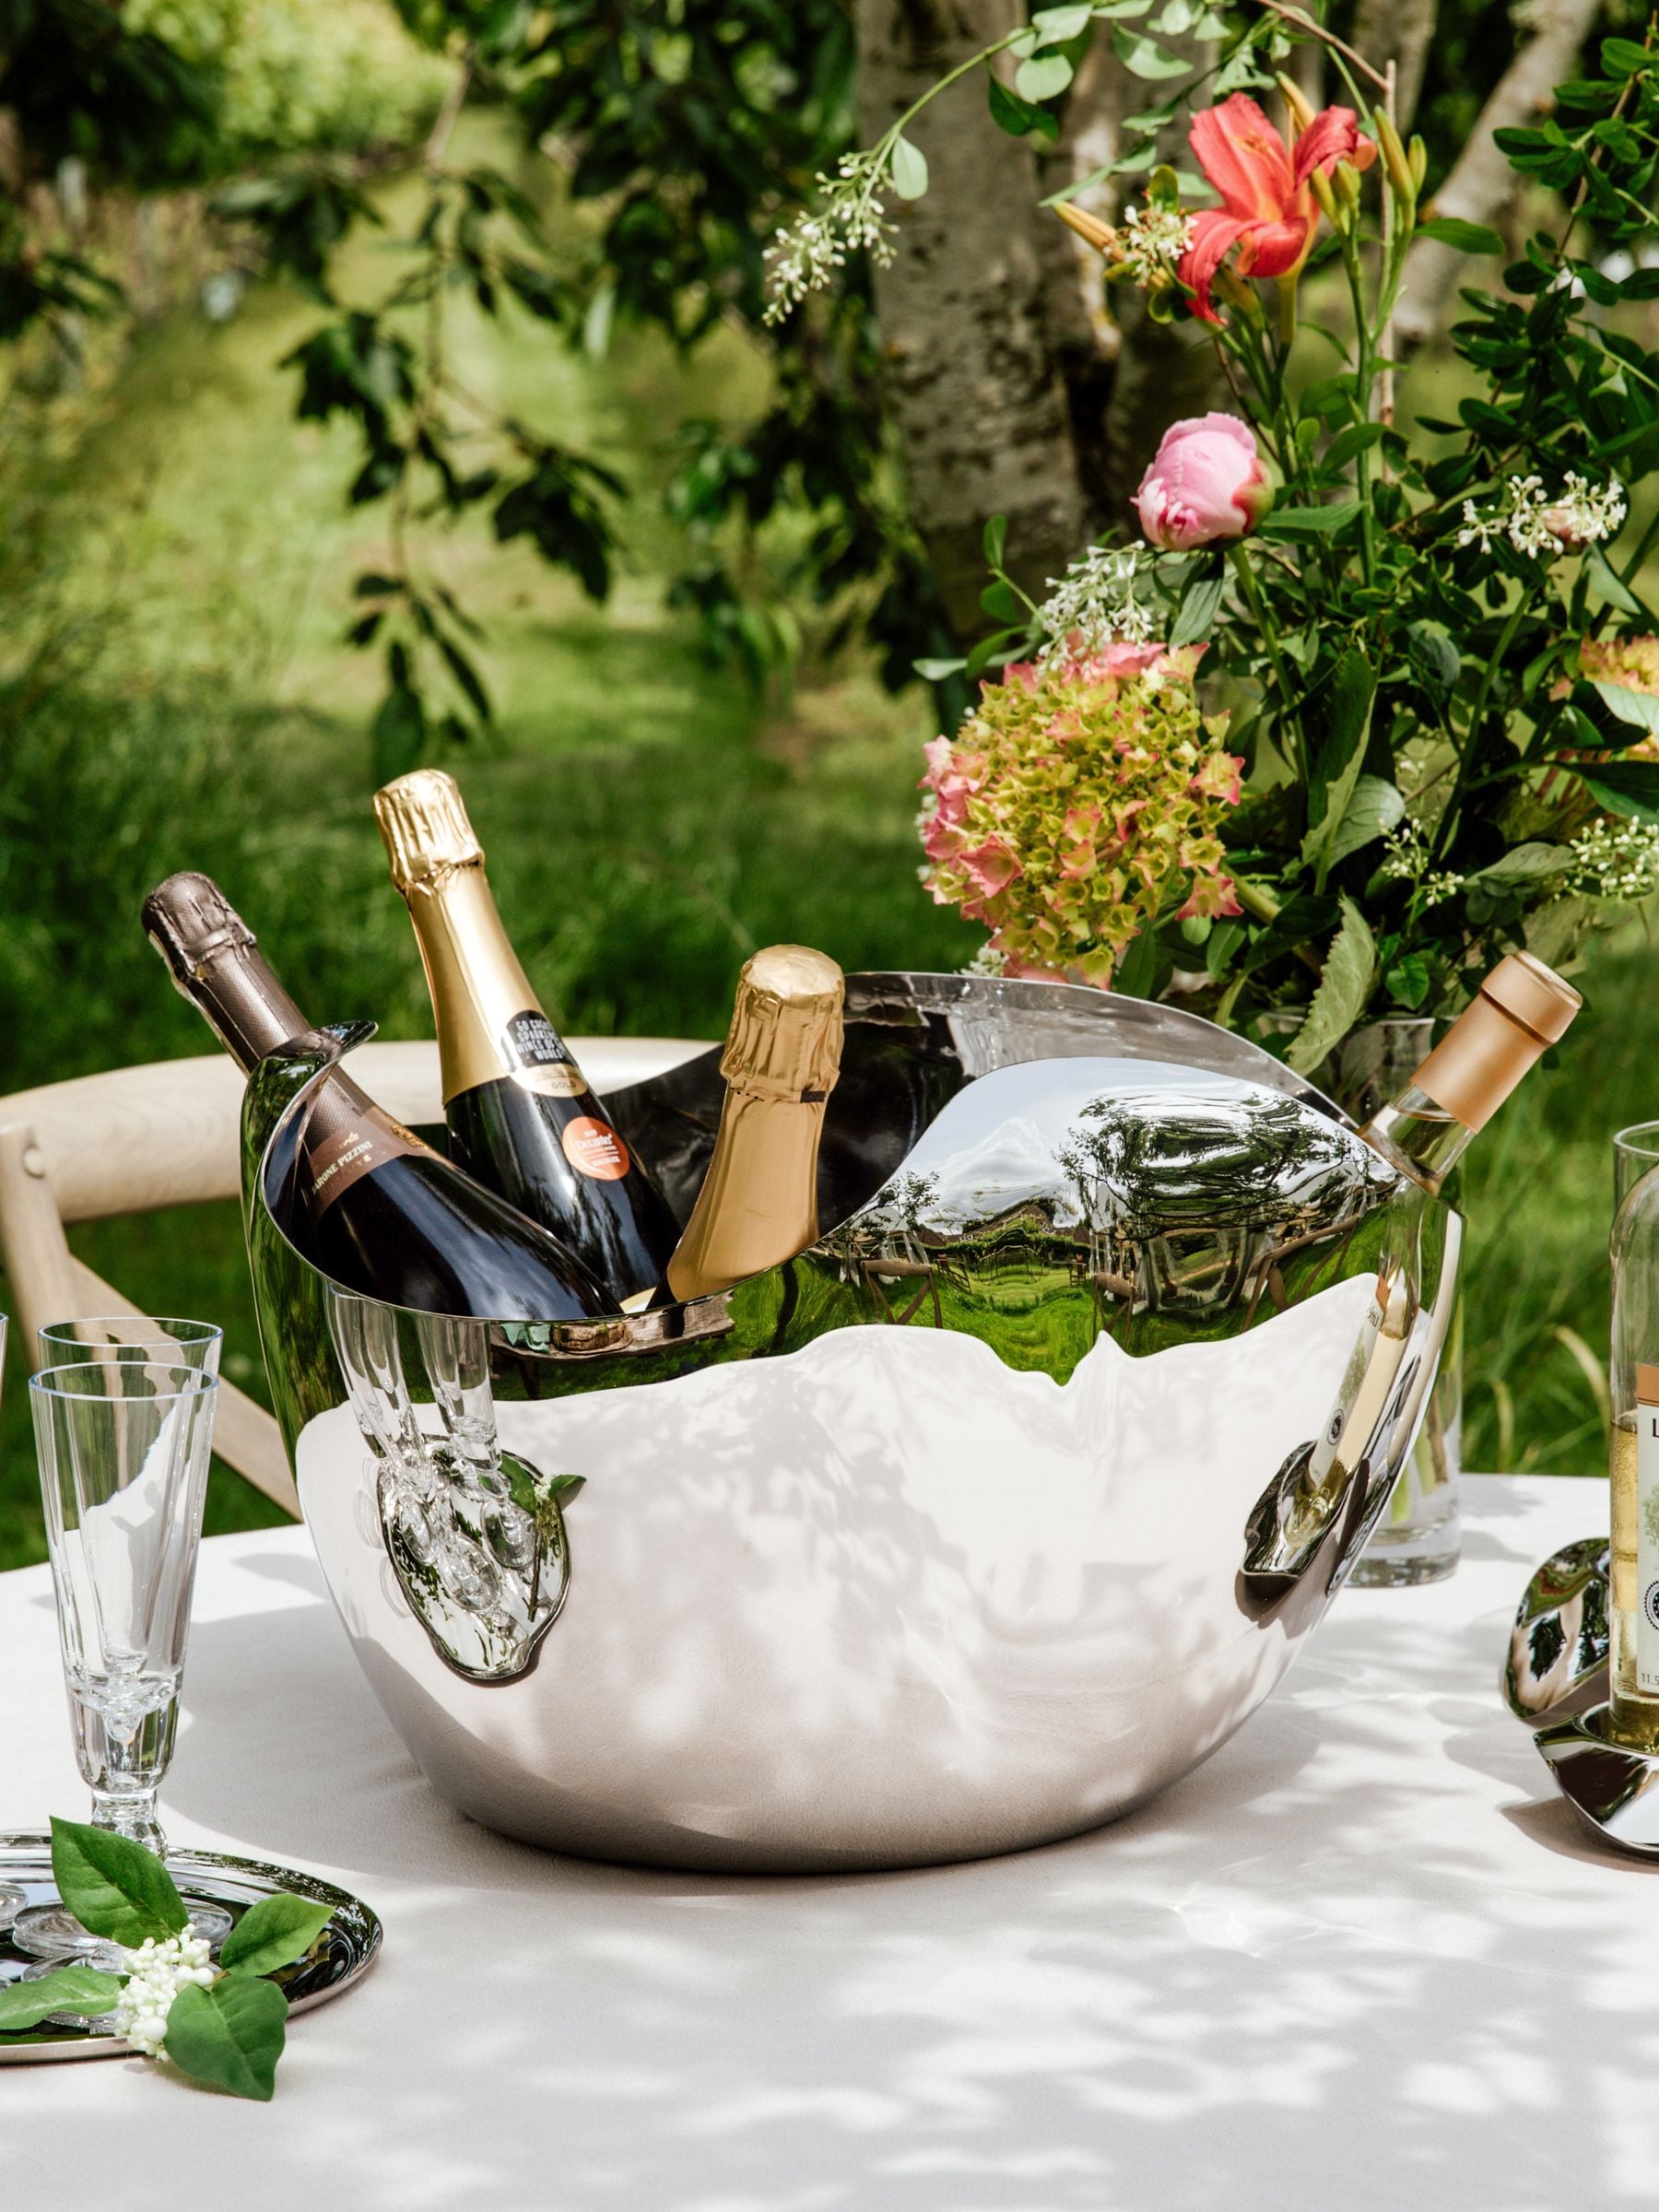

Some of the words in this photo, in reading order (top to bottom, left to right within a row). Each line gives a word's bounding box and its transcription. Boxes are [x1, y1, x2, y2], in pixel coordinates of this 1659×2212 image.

[516, 1040, 544, 1054] WINES
[534, 1048, 563, 1061] WORLD
[337, 1141, 373, 1167] PIZZINI
